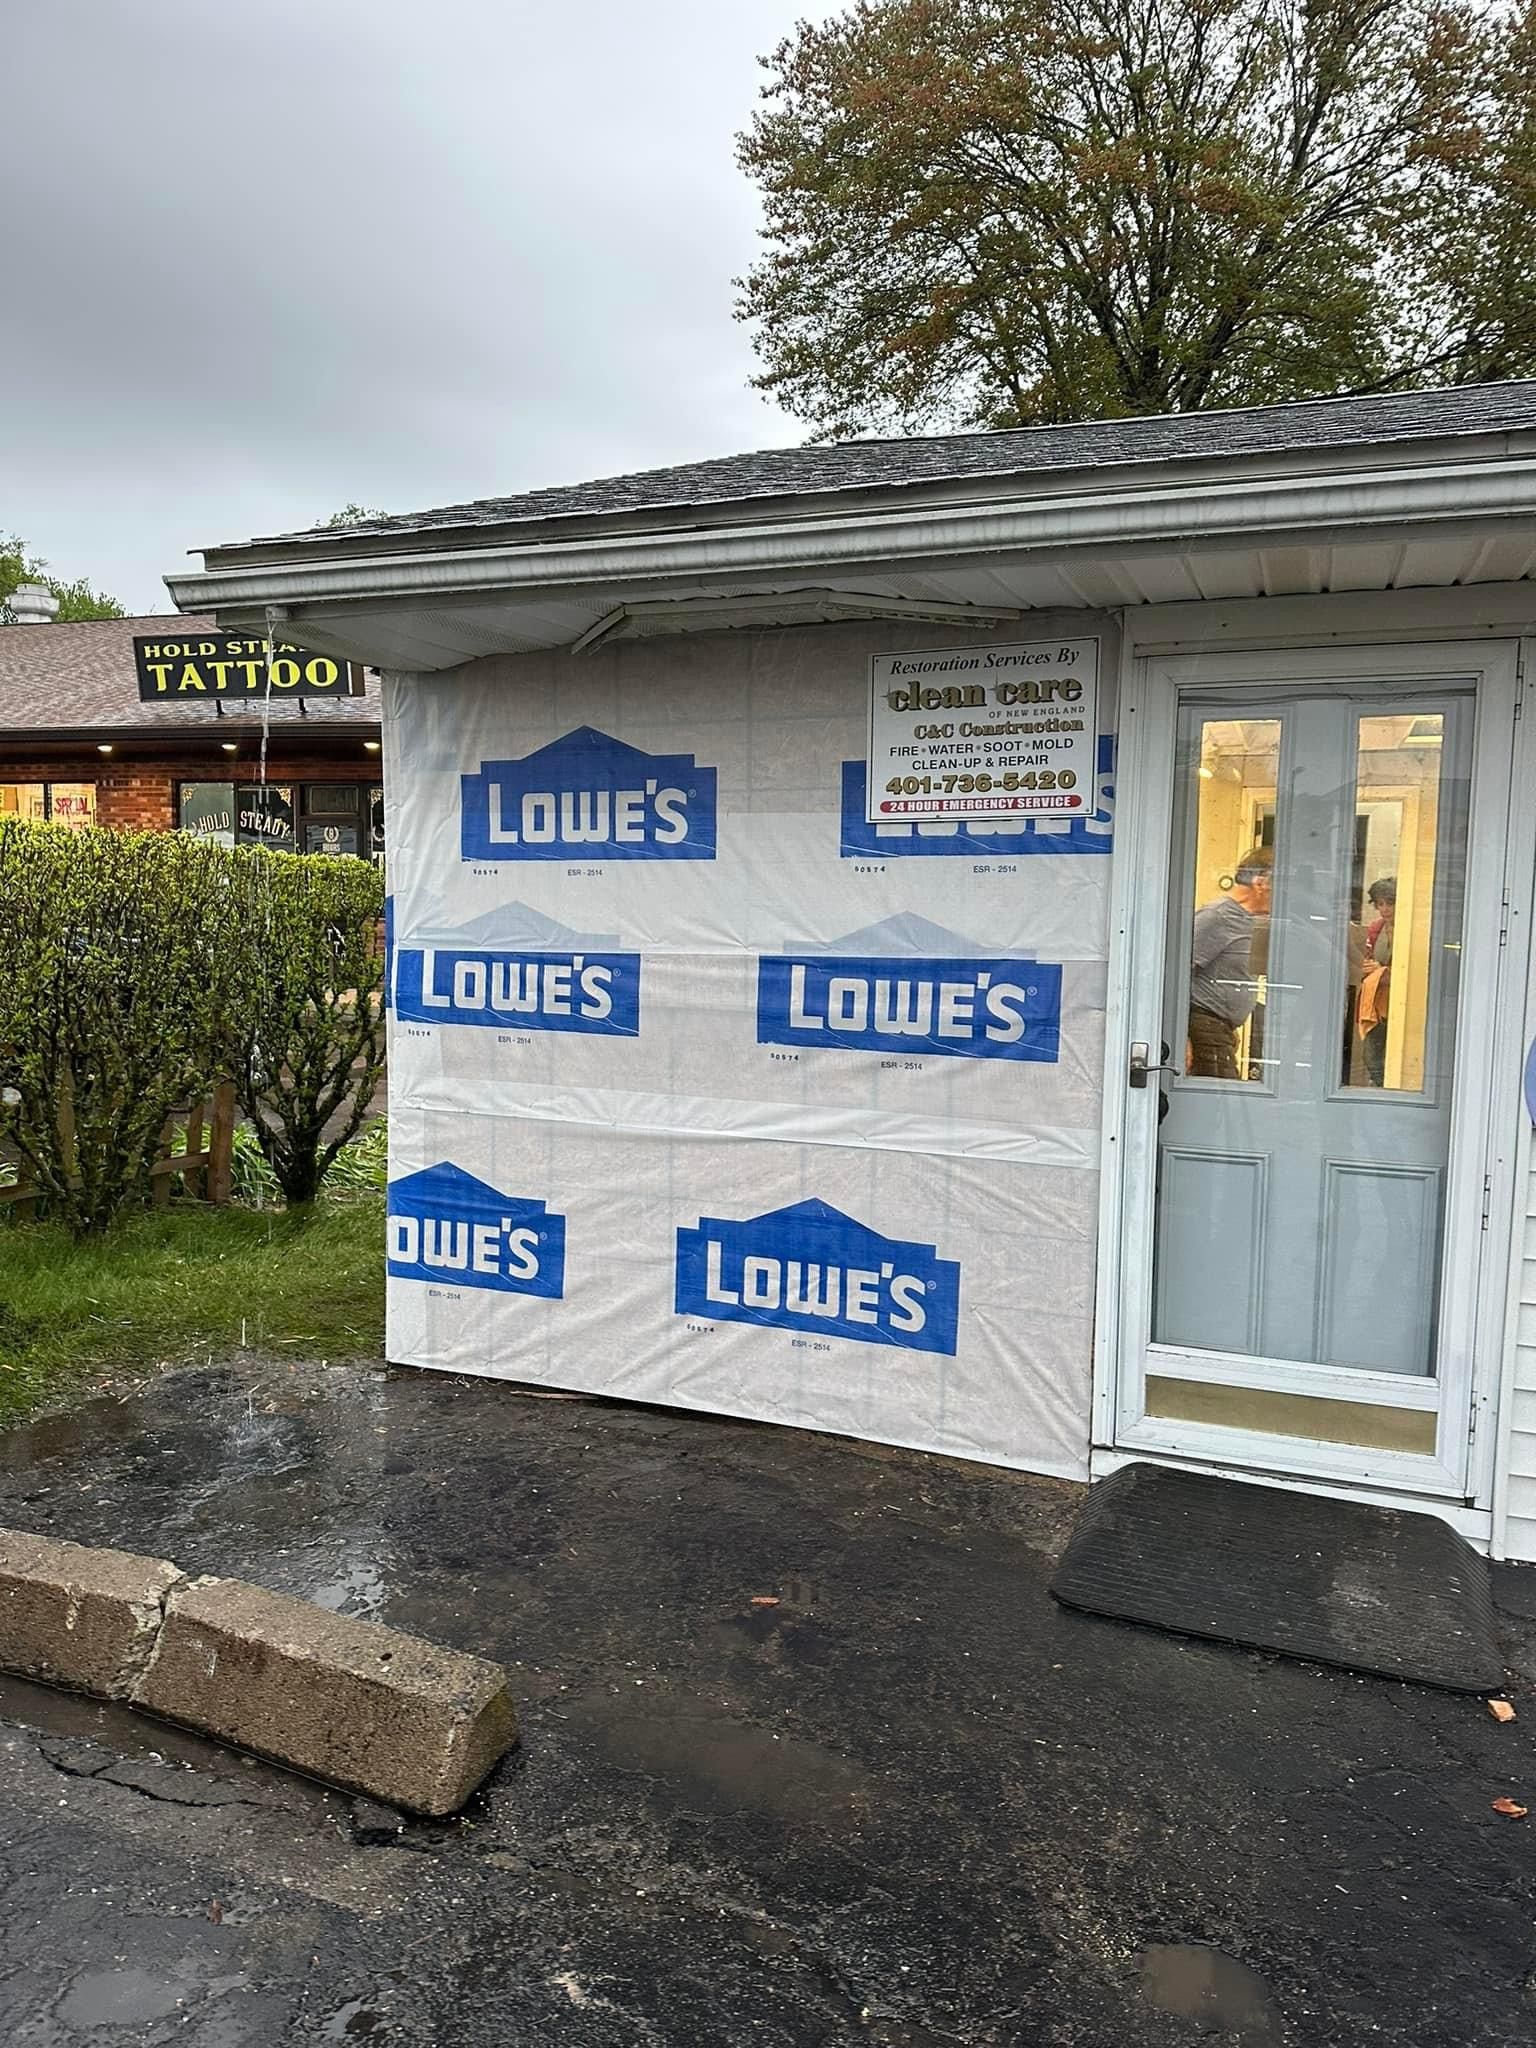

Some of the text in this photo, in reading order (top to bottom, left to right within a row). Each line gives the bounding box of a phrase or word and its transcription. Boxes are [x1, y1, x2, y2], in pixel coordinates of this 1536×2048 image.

[144, 643, 217, 658] HOLD
[890, 648, 1080, 675] Restoration Services By
[146, 657, 338, 692] TATTOO
[887, 677, 1083, 712] clean care
[989, 706, 1085, 719] OF NEW ENGLAND
[914, 718, 1084, 739] C&C Construction
[890, 738, 1074, 757] FIRE WATER SOOT MOLD
[912, 754, 1049, 770] CLEAN-UP & REPAIR
[886, 769, 1077, 796] 401-736-5420
[489, 779, 688, 844] LOWE'S
[890, 796, 1071, 812] 24 HOUR EMERGENCY SERVICE
[199, 810, 290, 840] HOLD STEADY
[973, 865, 991, 873] ESR
[999, 865, 1017, 873] 2514
[422, 950, 612, 1019] LOWE'S
[790, 964, 1026, 1043] LOWE'S
[881, 1061, 897, 1069] ESR
[904, 1062, 922, 1070] 2514
[388, 1213, 538, 1280] OWE'S
[706, 1240, 927, 1333] LOWE'S
